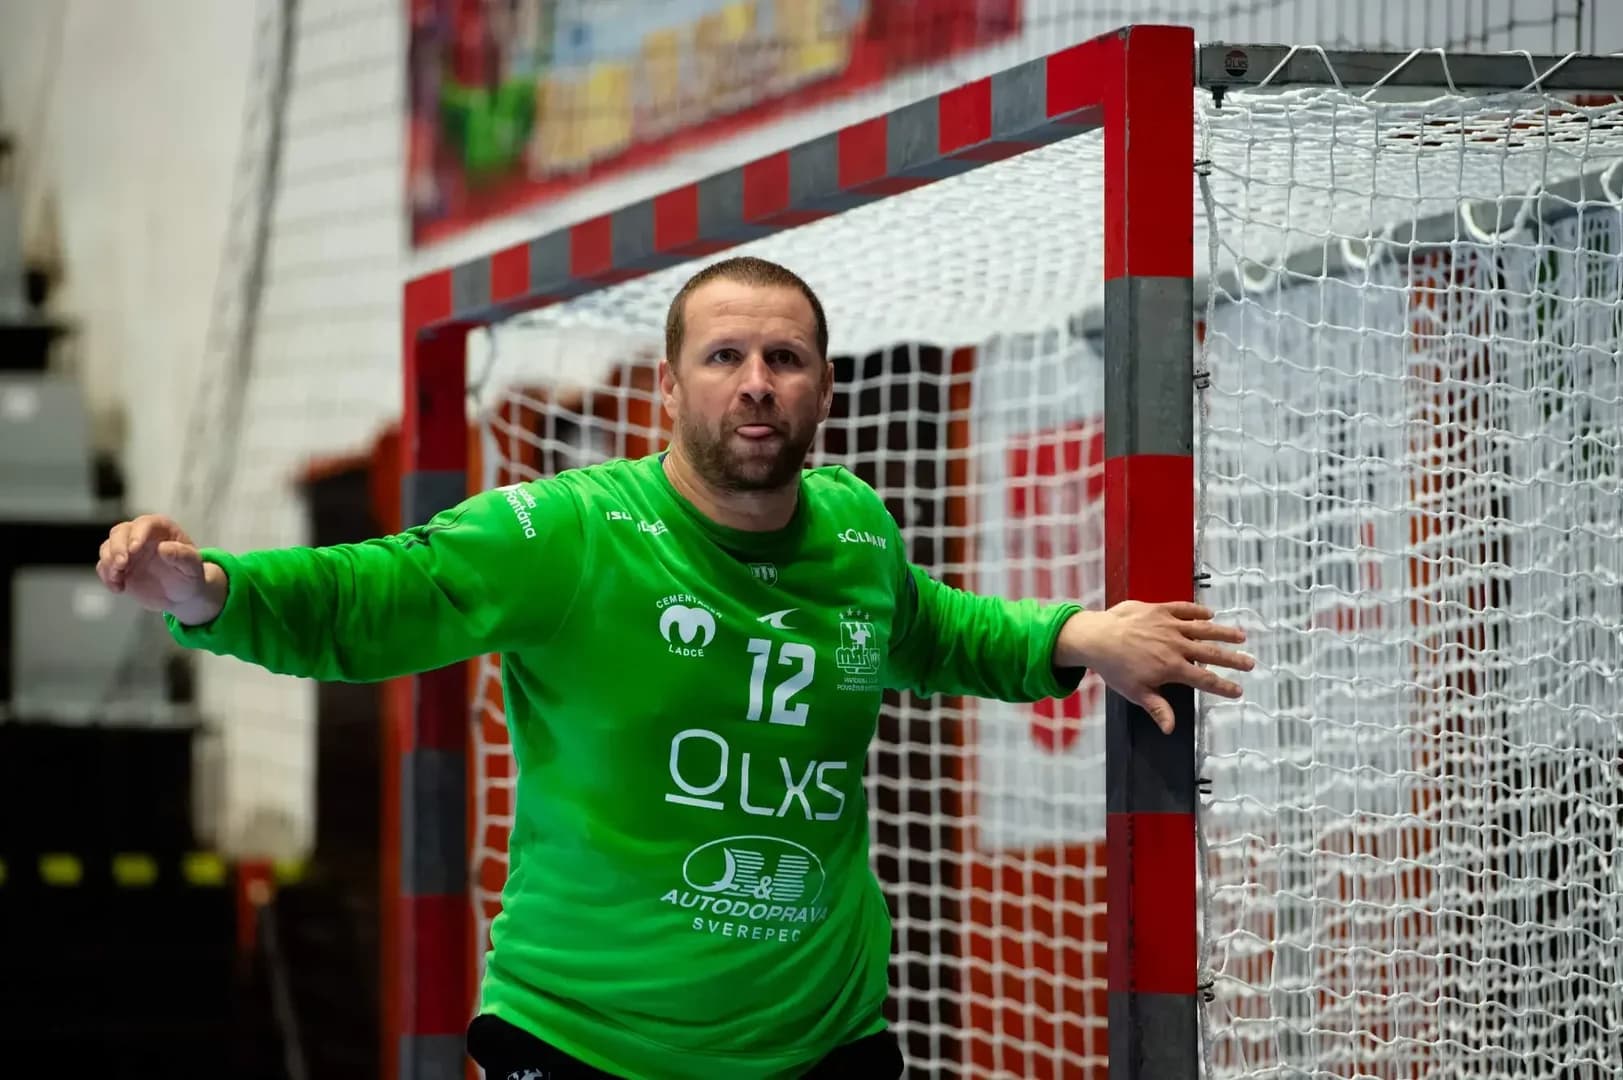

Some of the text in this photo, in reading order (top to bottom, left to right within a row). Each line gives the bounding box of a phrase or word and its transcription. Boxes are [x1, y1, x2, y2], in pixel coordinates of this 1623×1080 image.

[655, 593, 723, 619] CEMENT
[668, 643, 705, 657] LADCE
[746, 637, 816, 727] 12
[692, 916, 801, 943] SVEREPEC
